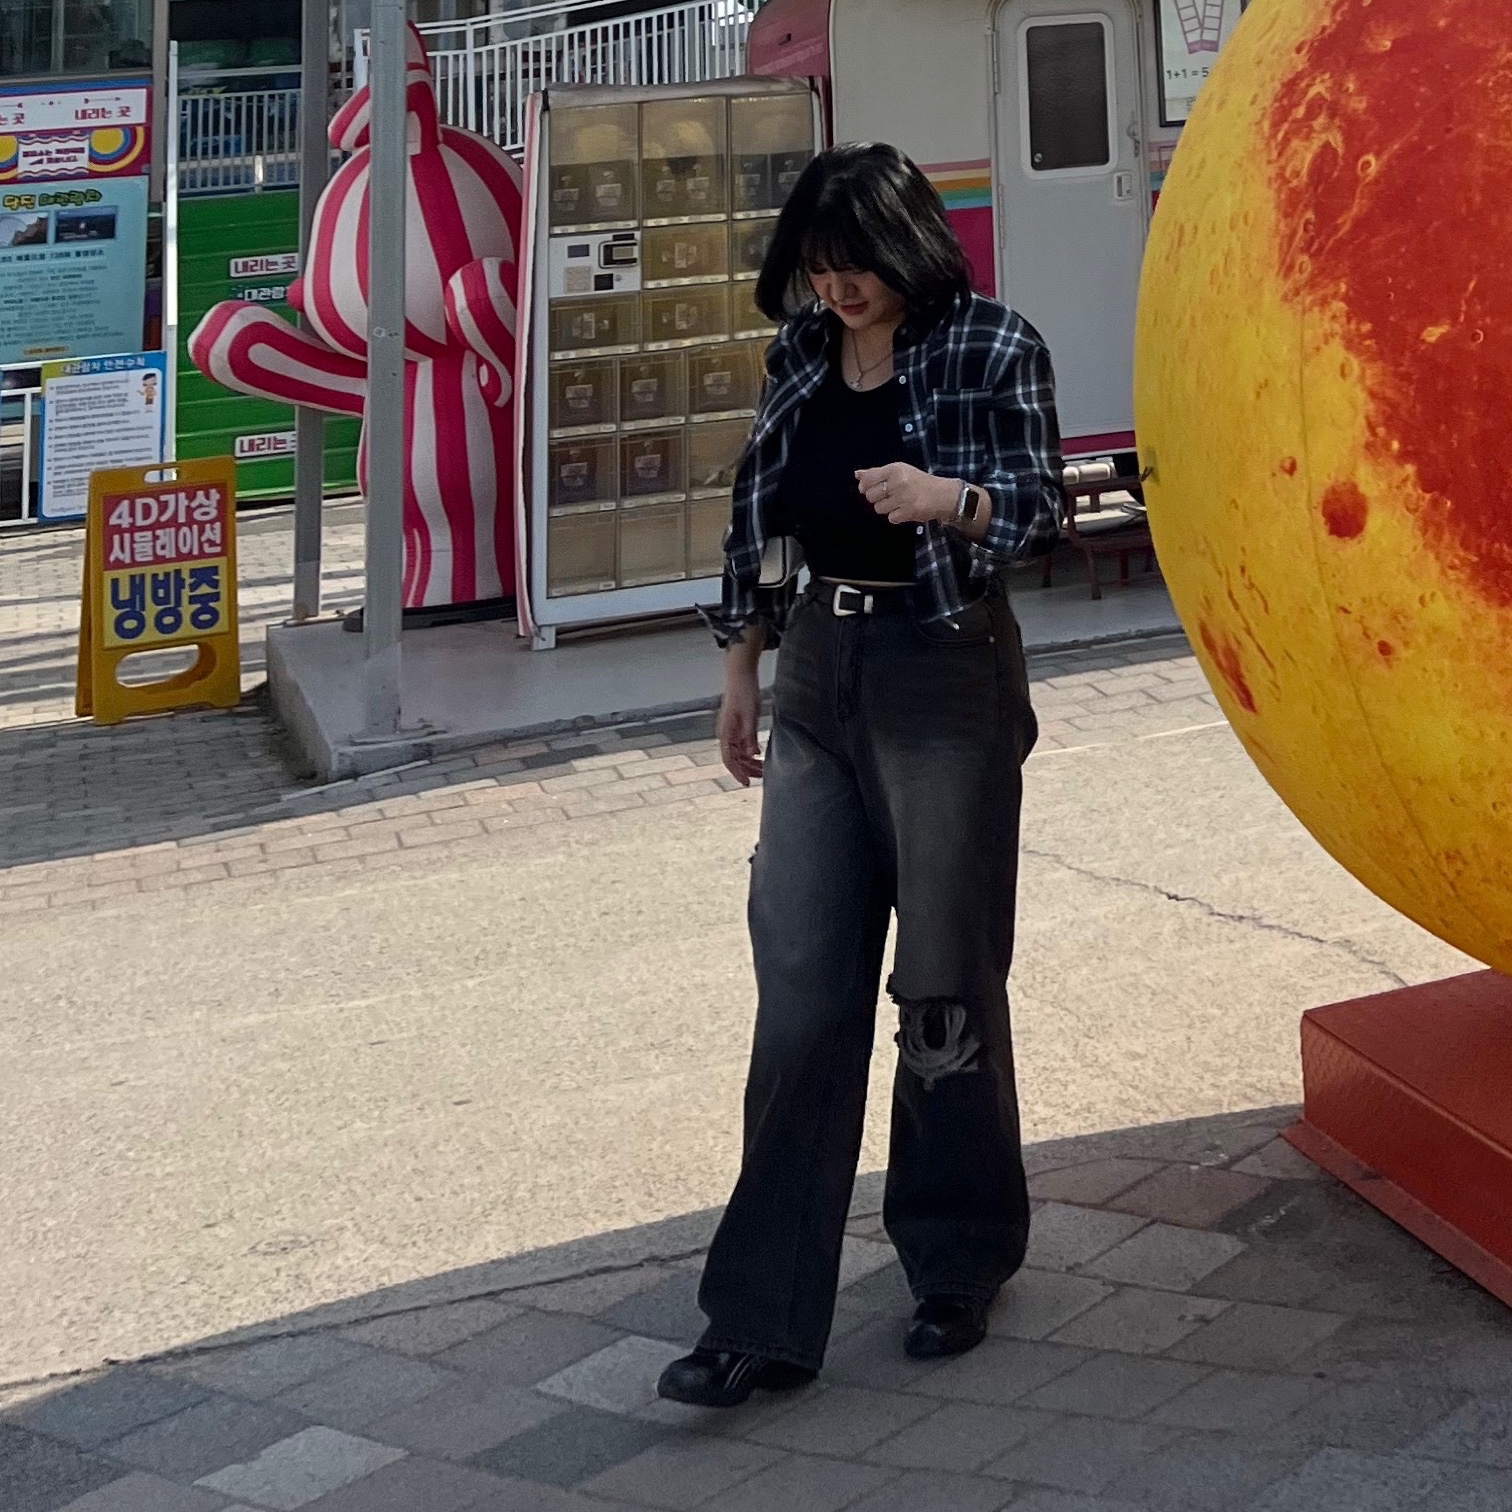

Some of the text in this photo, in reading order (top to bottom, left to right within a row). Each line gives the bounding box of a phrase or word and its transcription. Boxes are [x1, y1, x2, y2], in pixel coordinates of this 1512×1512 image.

[74, 105, 131, 122] 내리는 곳
[234, 255, 296, 274] 내리는 곳
[239, 436, 287, 454] 내리는
[109, 488, 220, 528] 4D가상
[109, 522, 222, 564] 시뮬레이션
[110, 565, 221, 640] 냉방중
